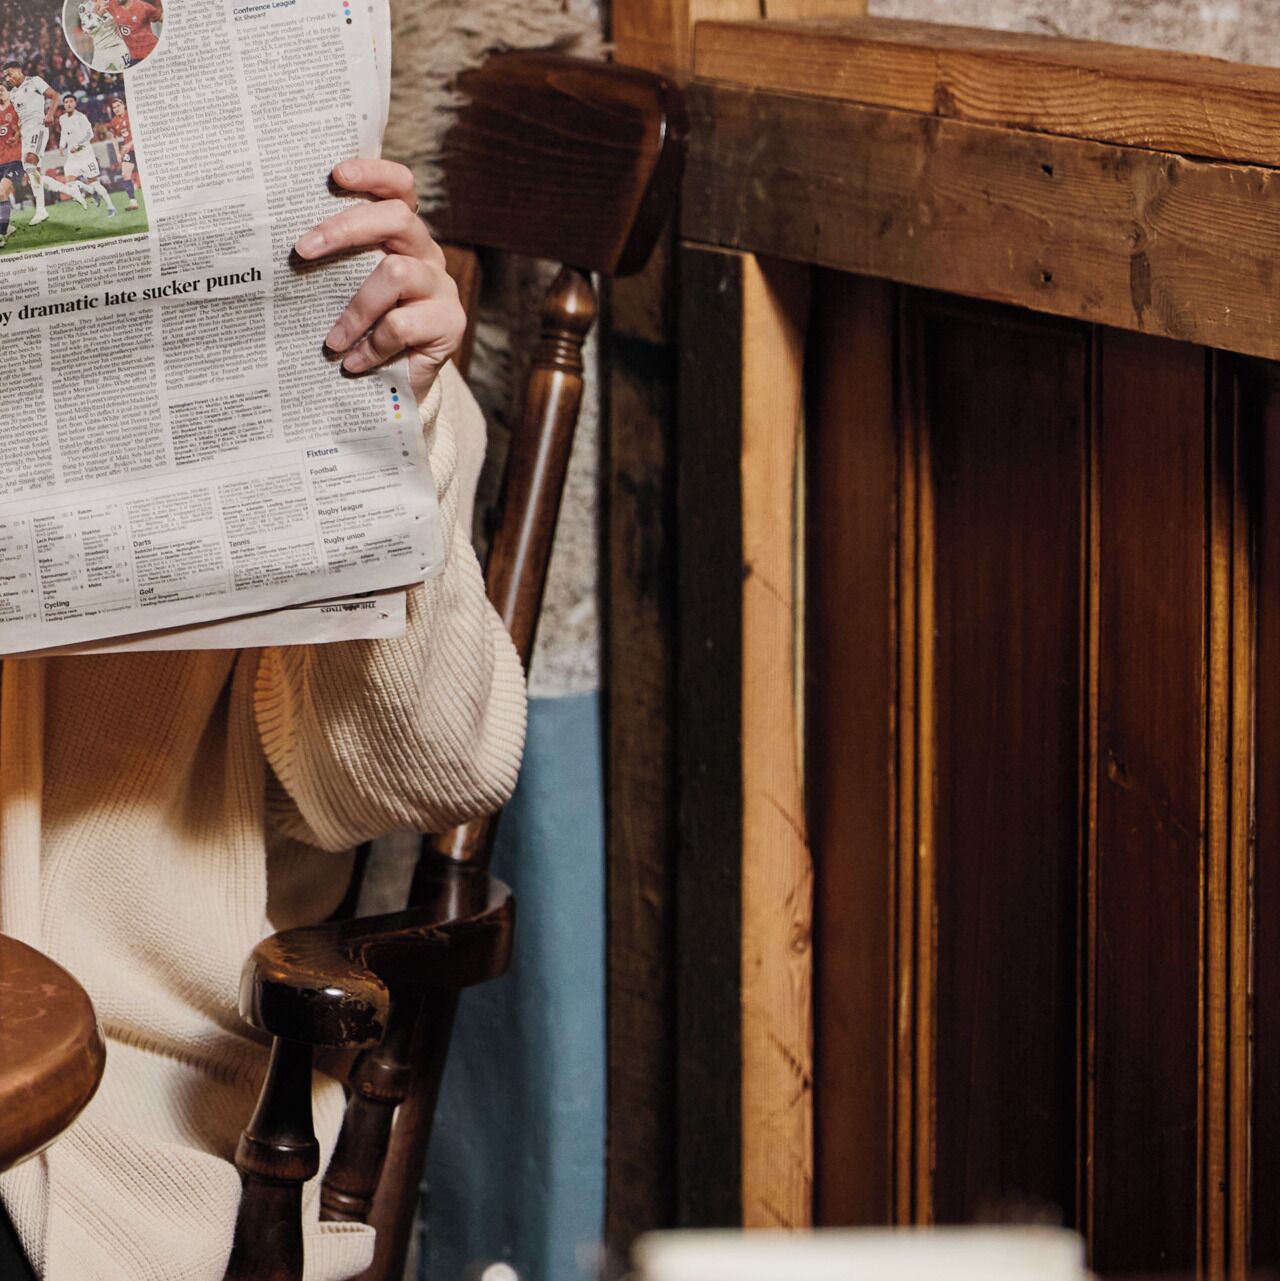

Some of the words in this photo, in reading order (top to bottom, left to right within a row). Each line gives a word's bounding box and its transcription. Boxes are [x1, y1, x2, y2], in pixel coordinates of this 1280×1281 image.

[233, 4, 271, 16] Conference
[244, 11, 267, 21] Shepard
[0, 254, 24, 264] stopped
[61, 246, 75, 254] from
[75, 242, 96, 252] scoring
[97, 239, 117, 250] against
[133, 234, 149, 244] again
[17, 295, 99, 322] dramatic
[104, 289, 137, 307] late
[142, 278, 201, 302] sucker
[205, 267, 263, 292] punch
[306, 446, 338, 458] Fixtures
[310, 465, 337, 475] Football
[318, 507, 339, 516] Rugby
[340, 502, 364, 514] league
[133, 539, 151, 548] Darts
[229, 538, 251, 548] Tennis
[324, 535, 345, 545] Rugby
[346, 532, 366, 540] union
[139, 587, 154, 596] Golf
[44, 600, 70, 610] Cycling
